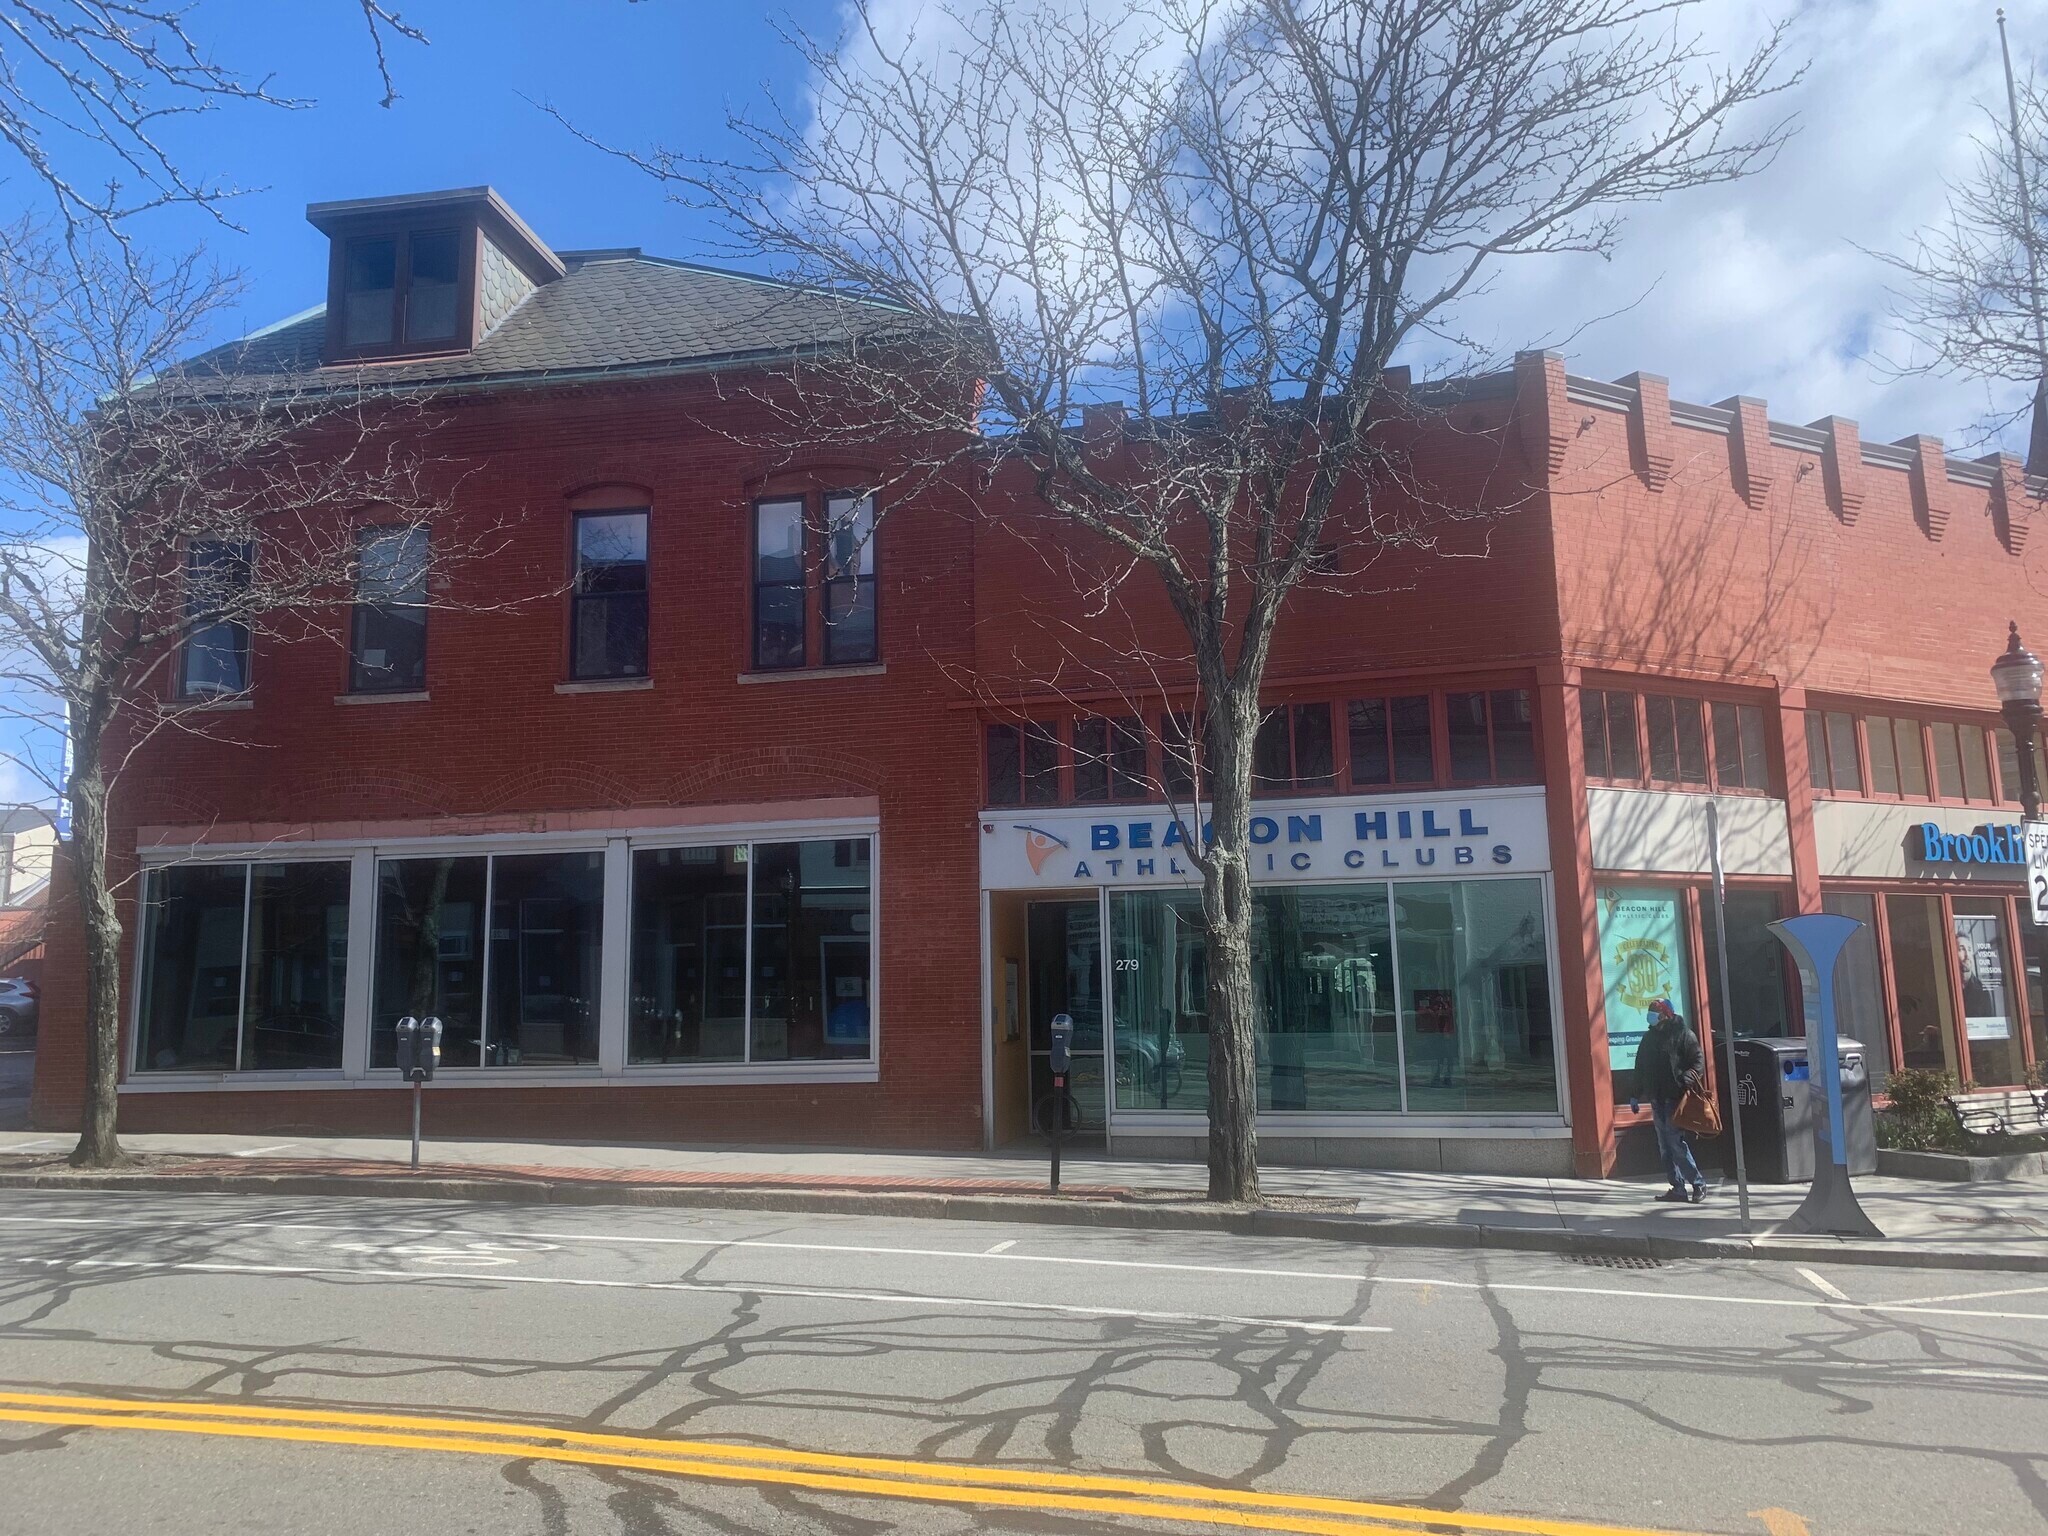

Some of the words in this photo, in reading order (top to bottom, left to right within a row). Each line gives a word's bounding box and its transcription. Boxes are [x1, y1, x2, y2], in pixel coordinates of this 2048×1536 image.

[1354, 809, 1489, 840] HILL
[1921, 822, 2026, 864] Brookli
[2029, 833, 2048, 849] SPE
[1074, 852, 1312, 877] ATHLIC
[1344, 845, 1512, 868] CLUBS
[2034, 855, 2048, 869] LIM
[2034, 875, 2048, 911] 2
[1115, 959, 1139, 971] 279
